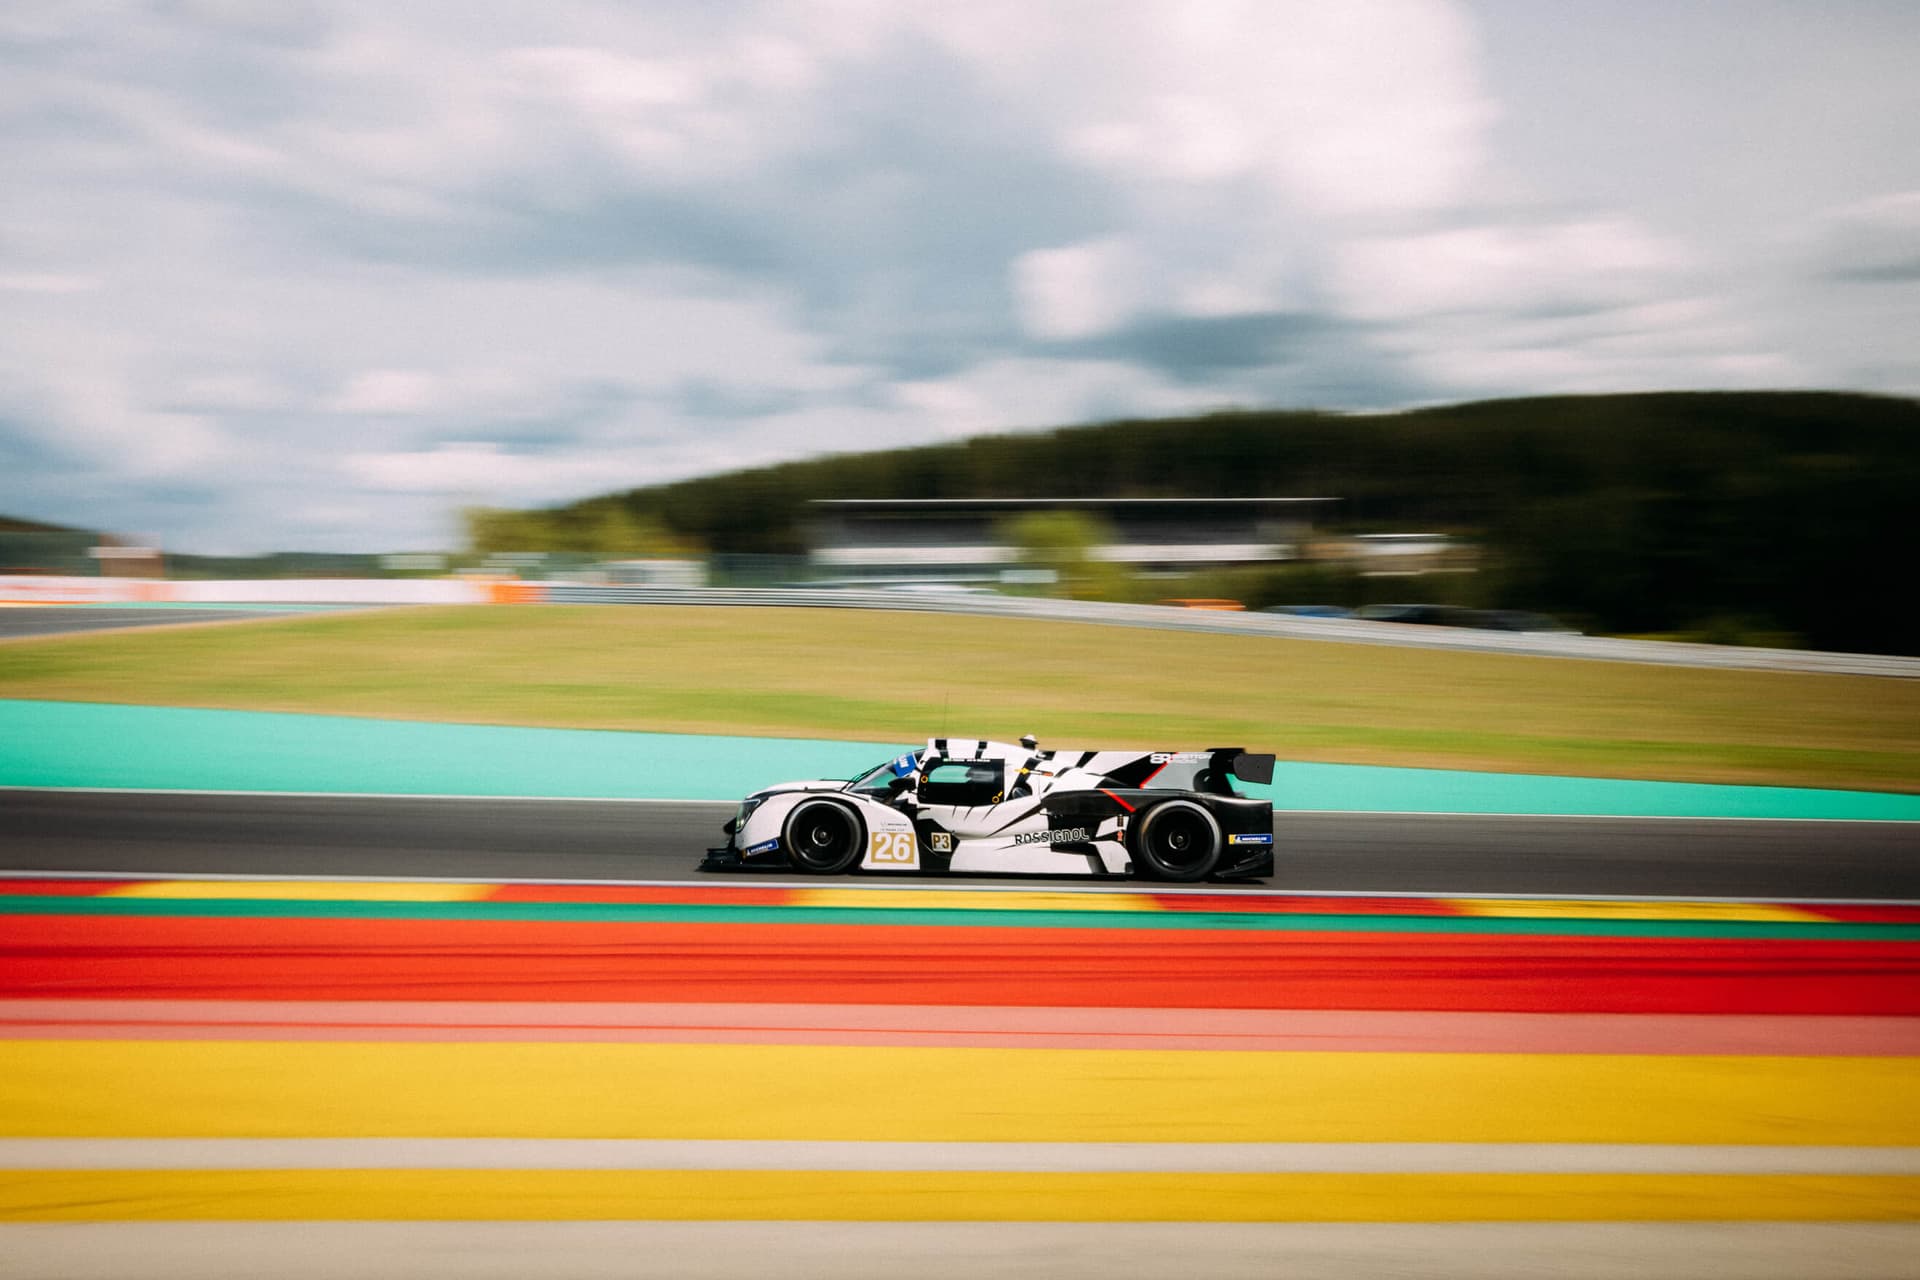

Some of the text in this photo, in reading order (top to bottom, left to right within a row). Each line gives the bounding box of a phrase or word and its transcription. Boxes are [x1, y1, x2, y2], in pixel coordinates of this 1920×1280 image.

[932, 834, 950, 849] P3
[1015, 827, 1089, 845] ROSSIGNOL
[875, 832, 911, 861] 26
